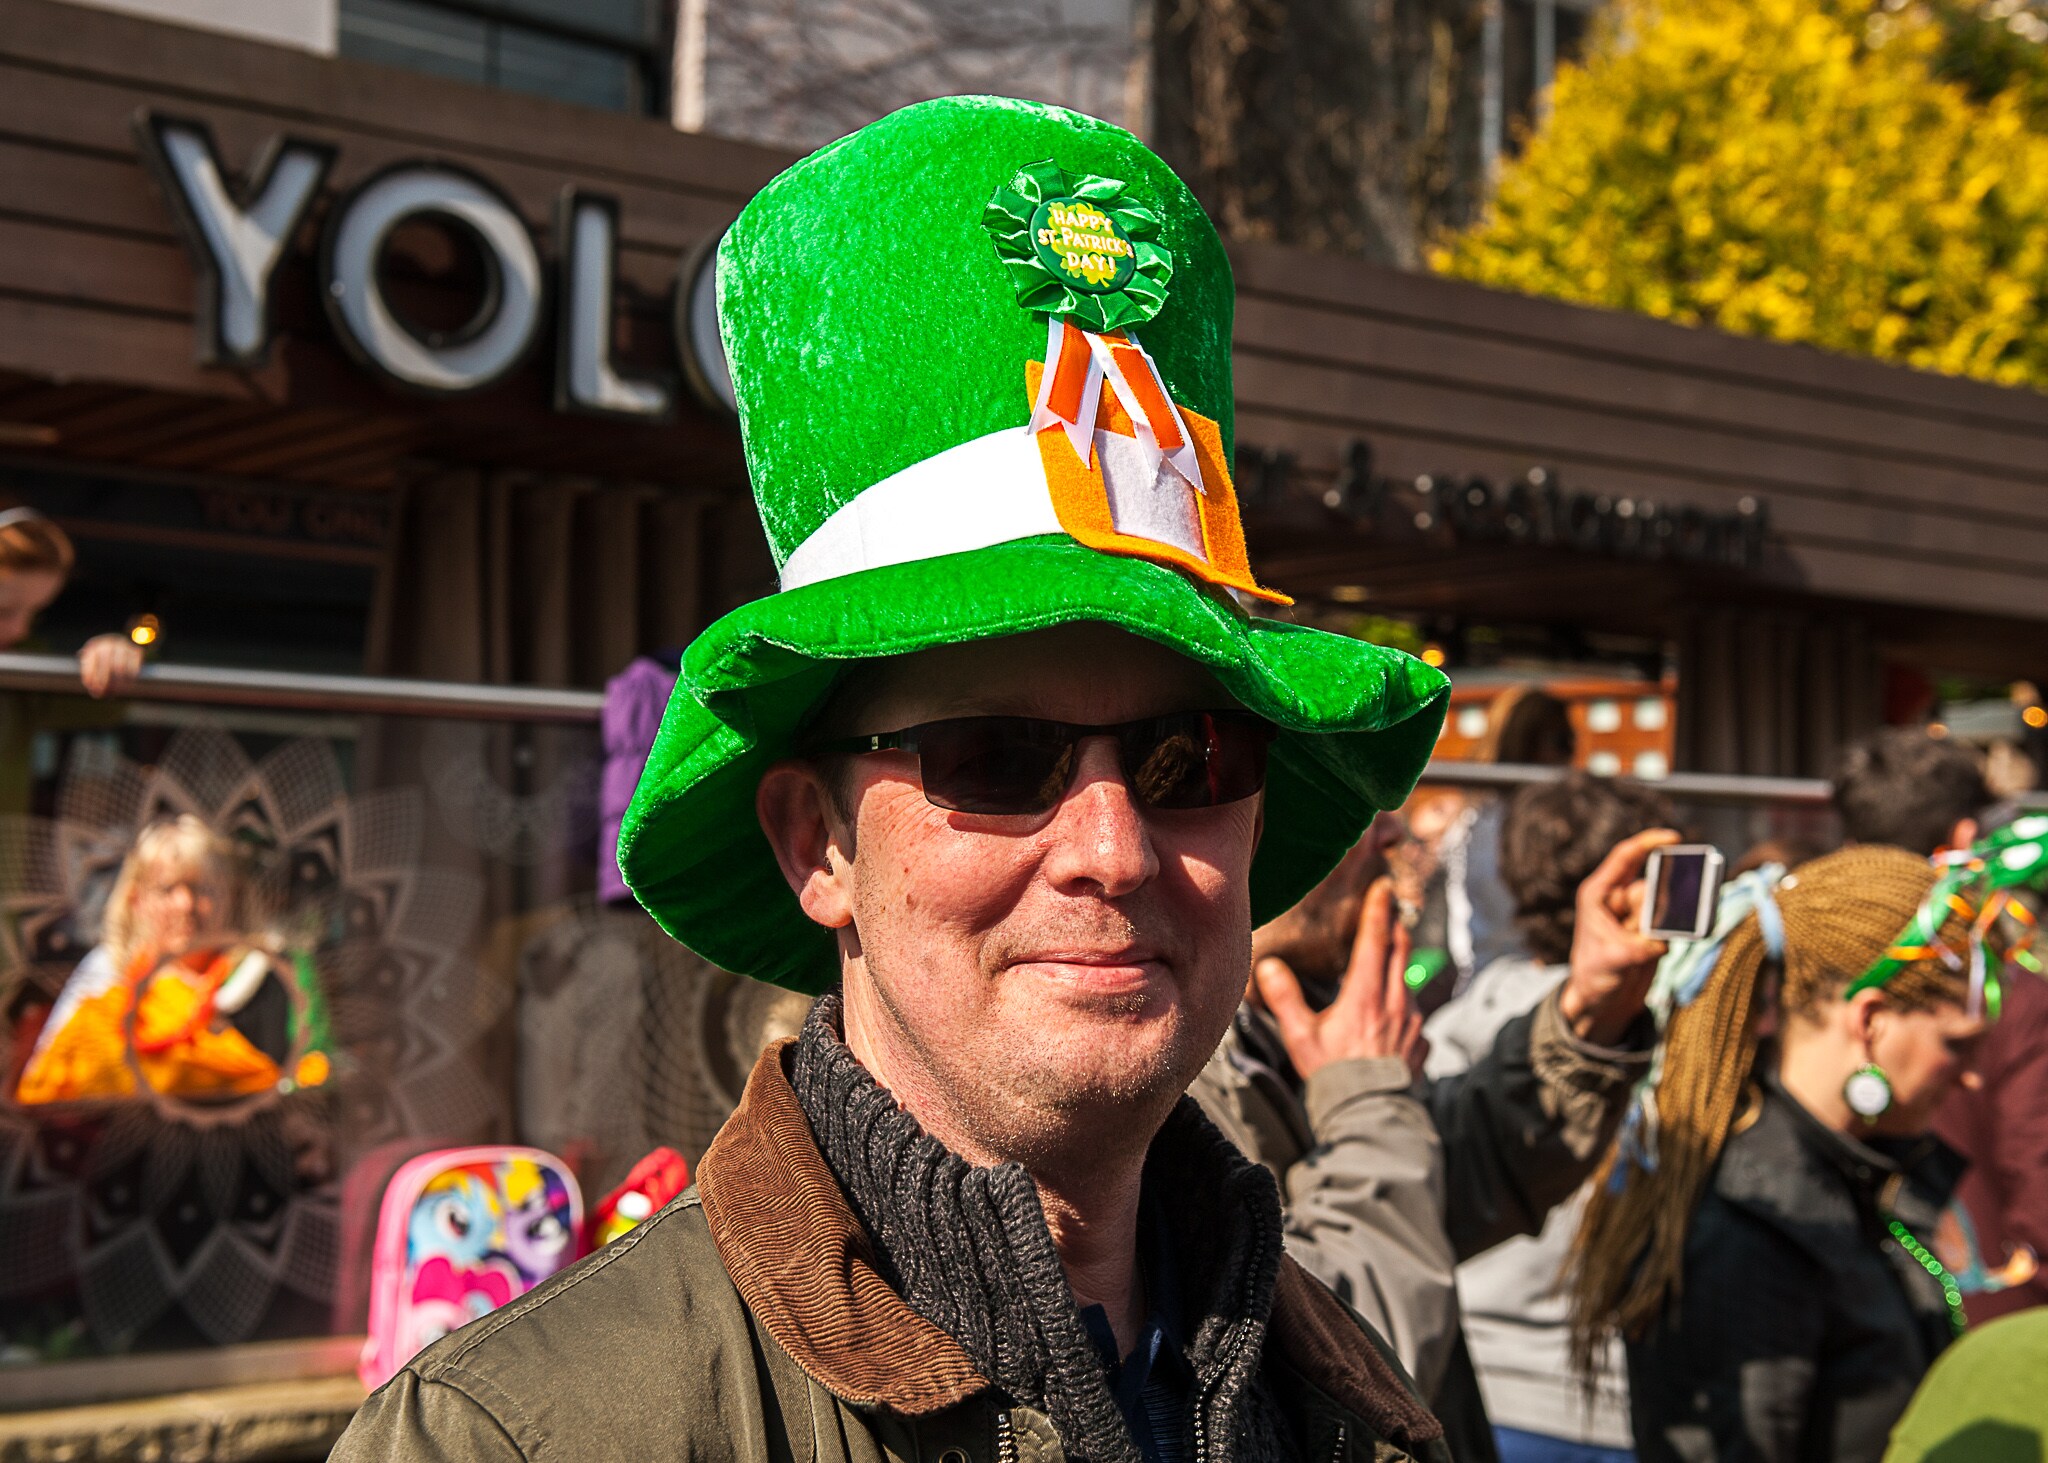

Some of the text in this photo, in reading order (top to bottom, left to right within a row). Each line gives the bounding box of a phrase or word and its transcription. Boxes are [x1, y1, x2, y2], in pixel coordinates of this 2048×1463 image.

[1052, 208, 1113, 232] HAPPY
[1037, 226, 1135, 258] ST. PATRICK'S
[133, 106, 740, 420] YOL
[1066, 251, 1116, 273] DAY!
